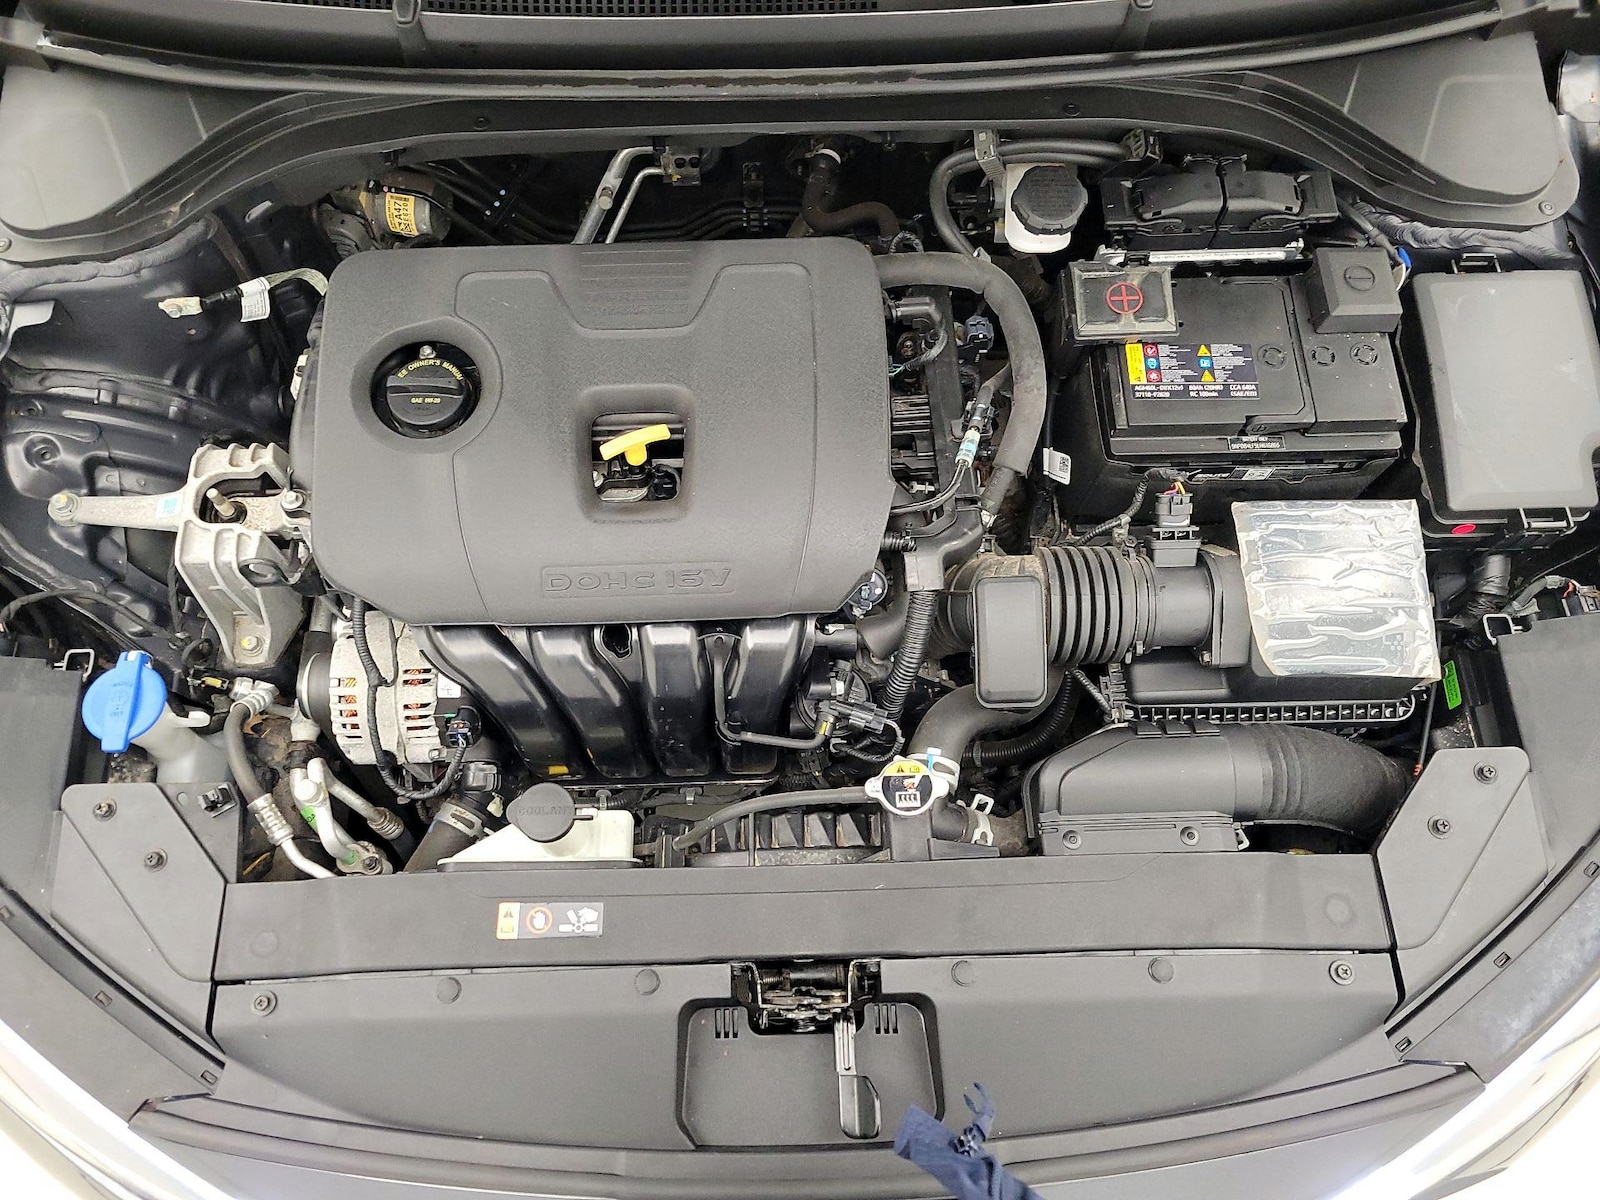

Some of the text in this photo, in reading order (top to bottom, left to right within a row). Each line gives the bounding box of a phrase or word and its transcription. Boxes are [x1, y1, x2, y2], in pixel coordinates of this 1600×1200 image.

[408, 359, 441, 371] OWNER'S
[544, 567, 732, 592] DOHC 16V
